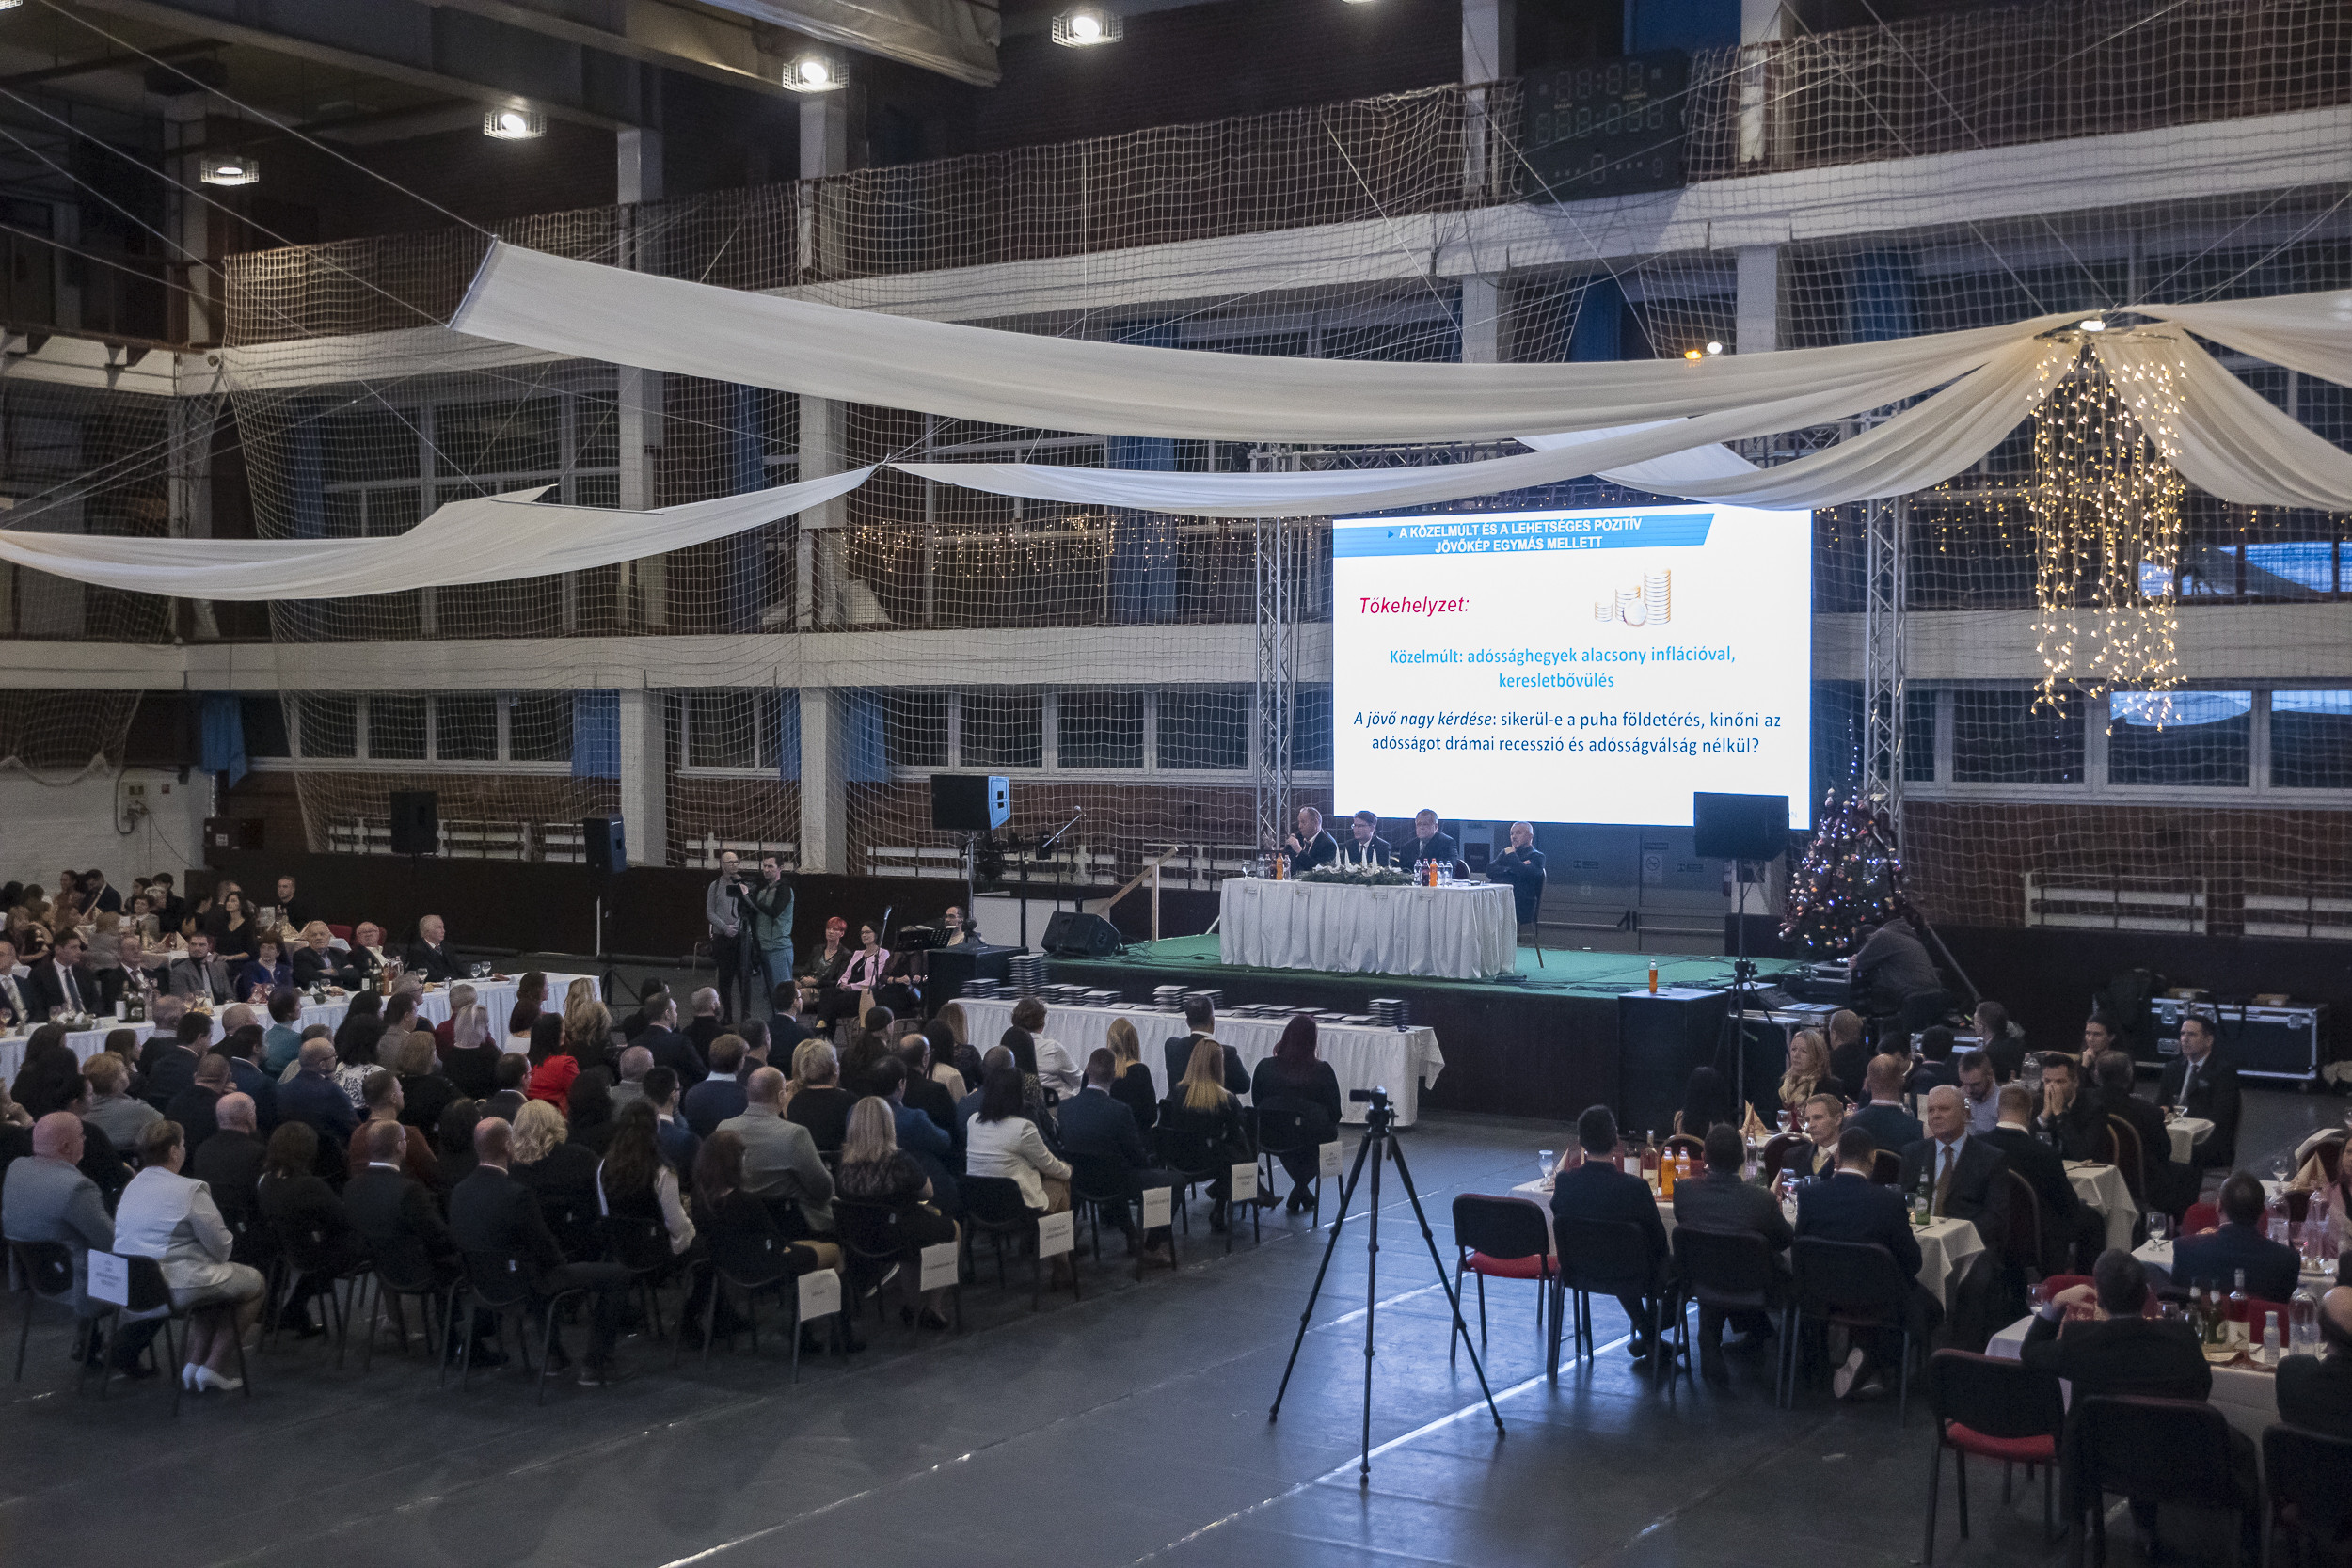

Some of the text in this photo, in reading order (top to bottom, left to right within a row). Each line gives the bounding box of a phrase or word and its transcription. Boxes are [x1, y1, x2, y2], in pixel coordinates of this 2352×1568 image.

[1399, 516, 1643, 539] A KÖZELMÚLT ÉS A LEHETSÉGES POZITÍV
[1435, 536, 1603, 553] JÖVŐKÉP EGYMÁS MELLETT
[1359, 595, 1470, 618] Tőkehelyzet:
[1390, 645, 1736, 667] Közelmúlt: adóssághegyek alacsony inflációval,
[1499, 672, 1614, 689] keresletbővülés
[1353, 710, 1781, 730] A jövő nagy kérdése: sikerül-e a puha földetérés, kinőni az
[1372, 735, 1760, 757] adósságot drámai recesszió és adósságválság nélkül?
